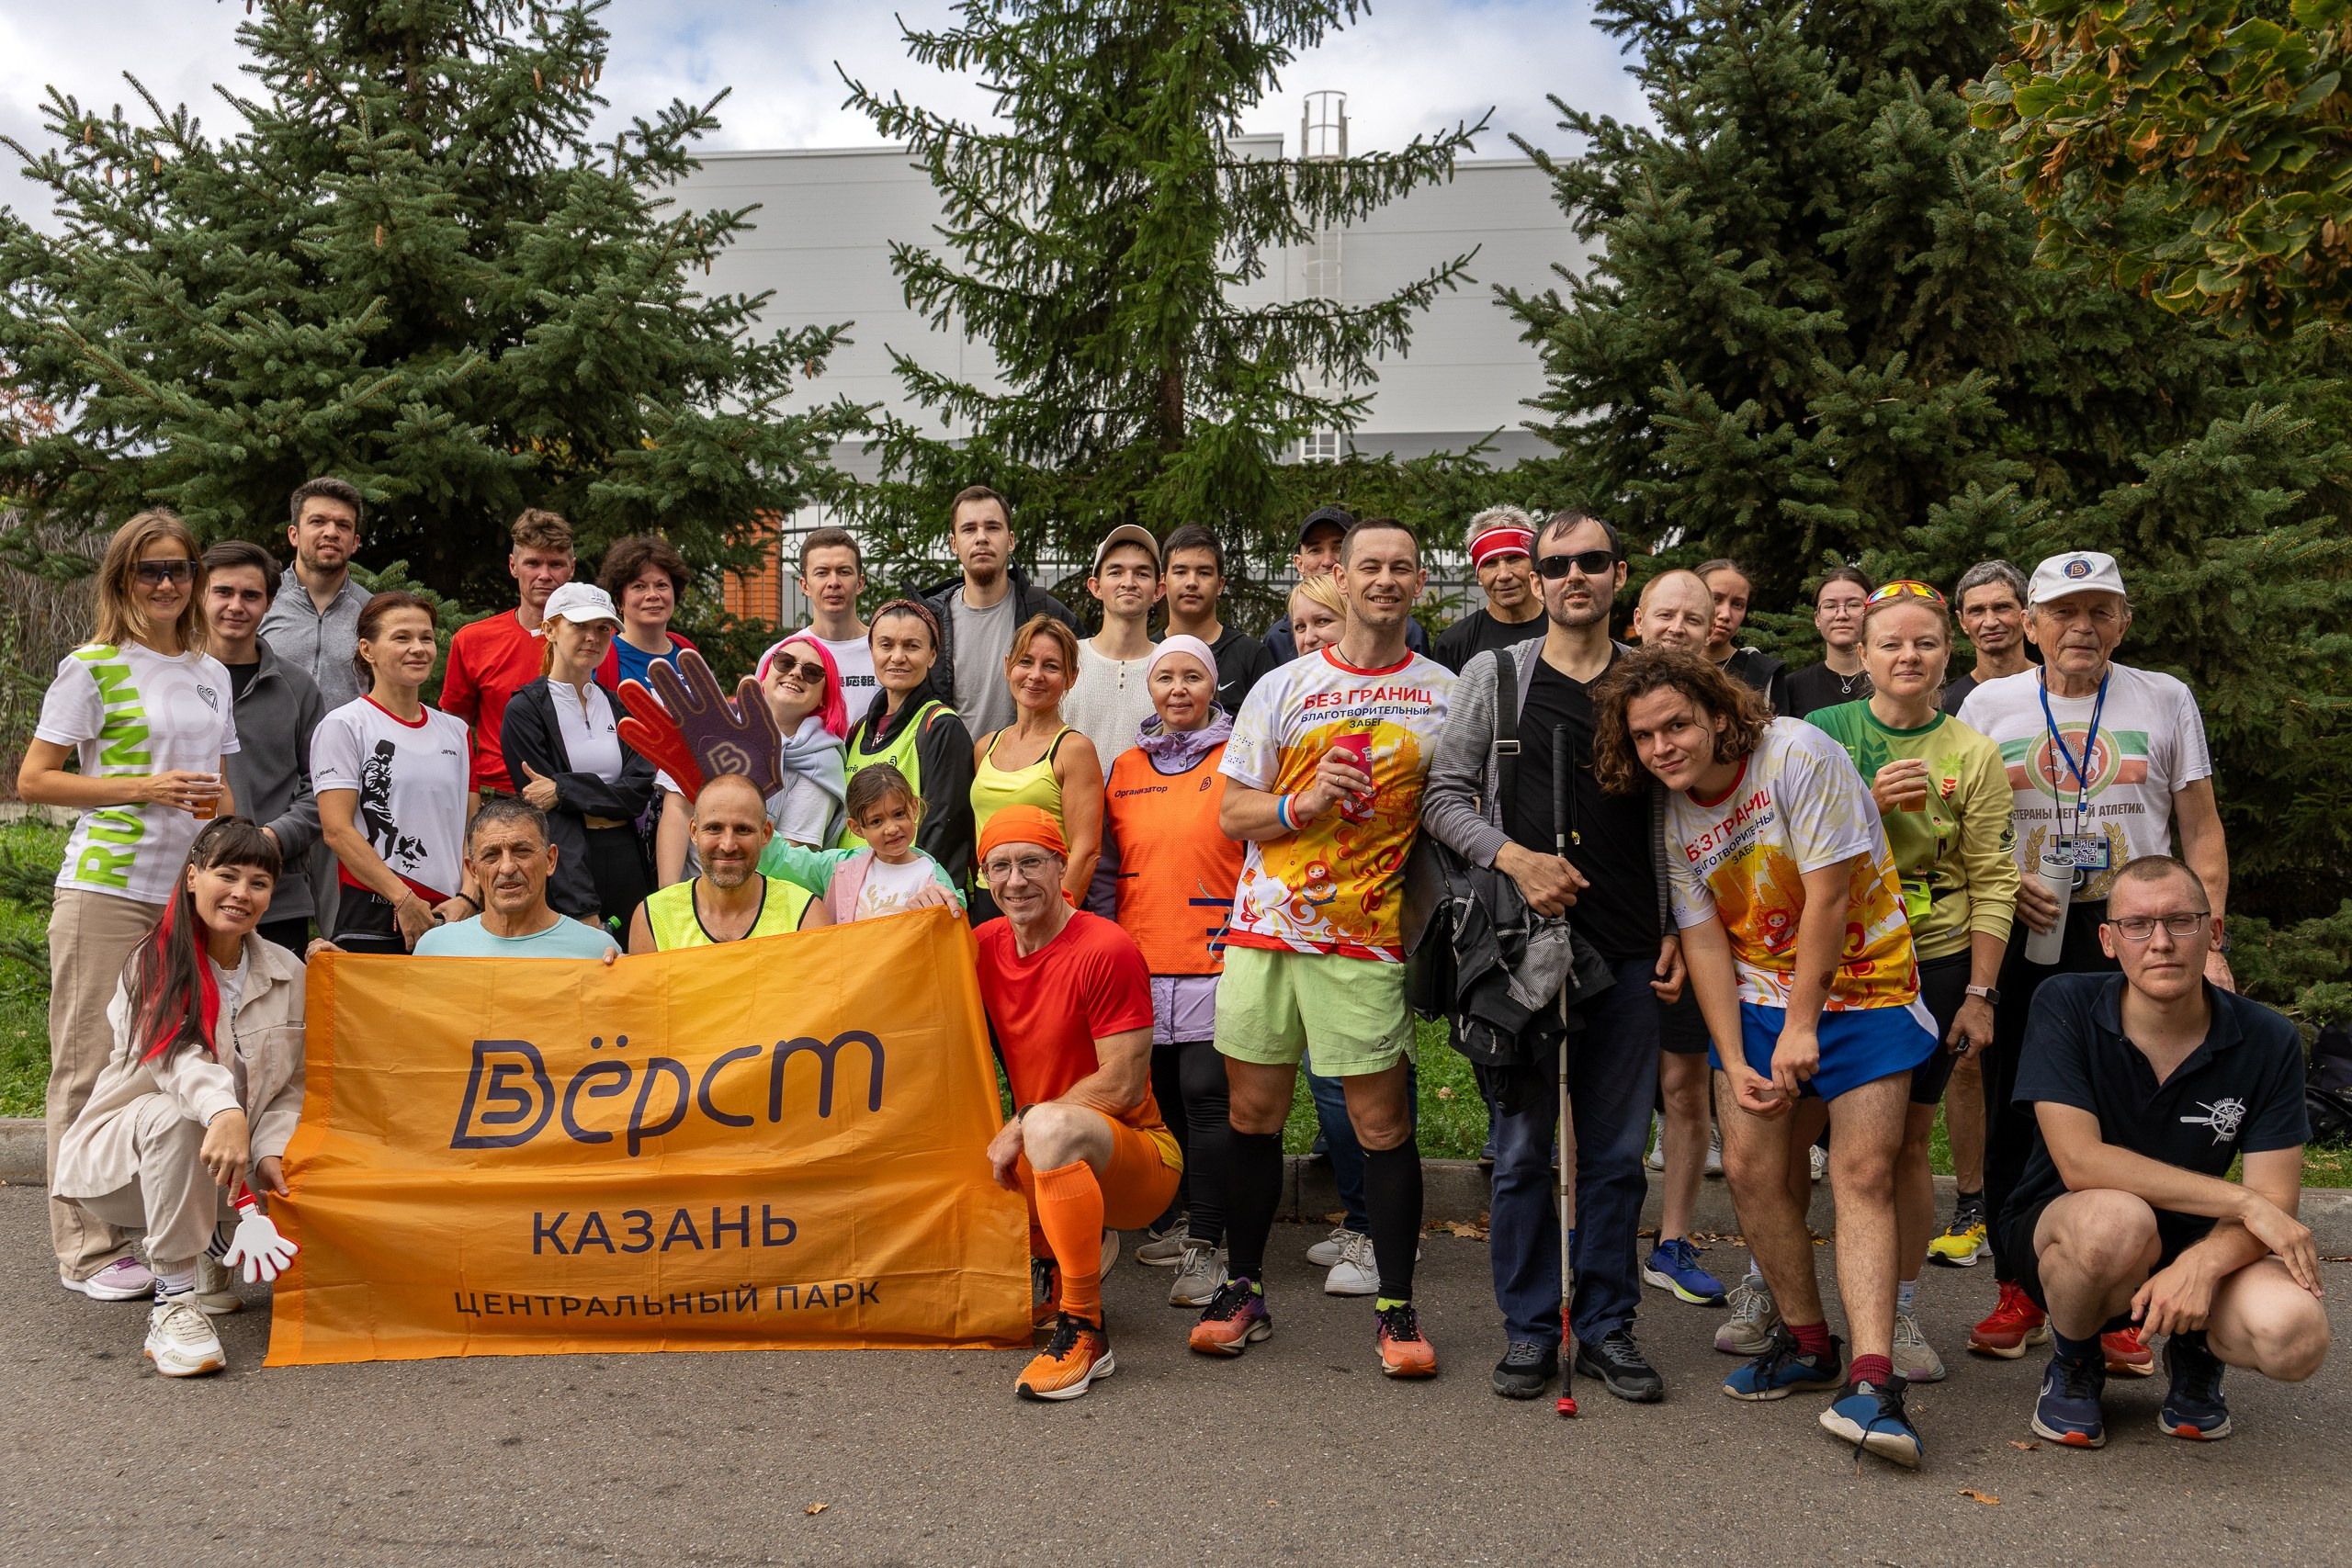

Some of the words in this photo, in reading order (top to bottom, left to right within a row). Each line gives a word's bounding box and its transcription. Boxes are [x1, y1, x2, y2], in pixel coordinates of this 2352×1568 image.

[1303, 692, 1342, 710] БЕЗ
[1347, 686, 1432, 705] ГРАНИЦ
[1300, 705, 1430, 723] БЛАГОТВОРИТЕЛЬНЫЙ
[1349, 717, 1385, 728] ЗАБЕГ
[71, 645, 153, 889] RUNIN
[1114, 785, 1168, 798] Организатор
[2013, 807, 2052, 820] ЕТЕРАНЫ
[2055, 804, 2096, 819] ЛЕГЙ
[370, 894, 392, 906] 188
[533, 1204, 797, 1255] КАЗАНЬ
[454, 1284, 759, 1318] ЦЕНТРАЛЬНЫЙ
[776, 1280, 881, 1312] ПАРК
